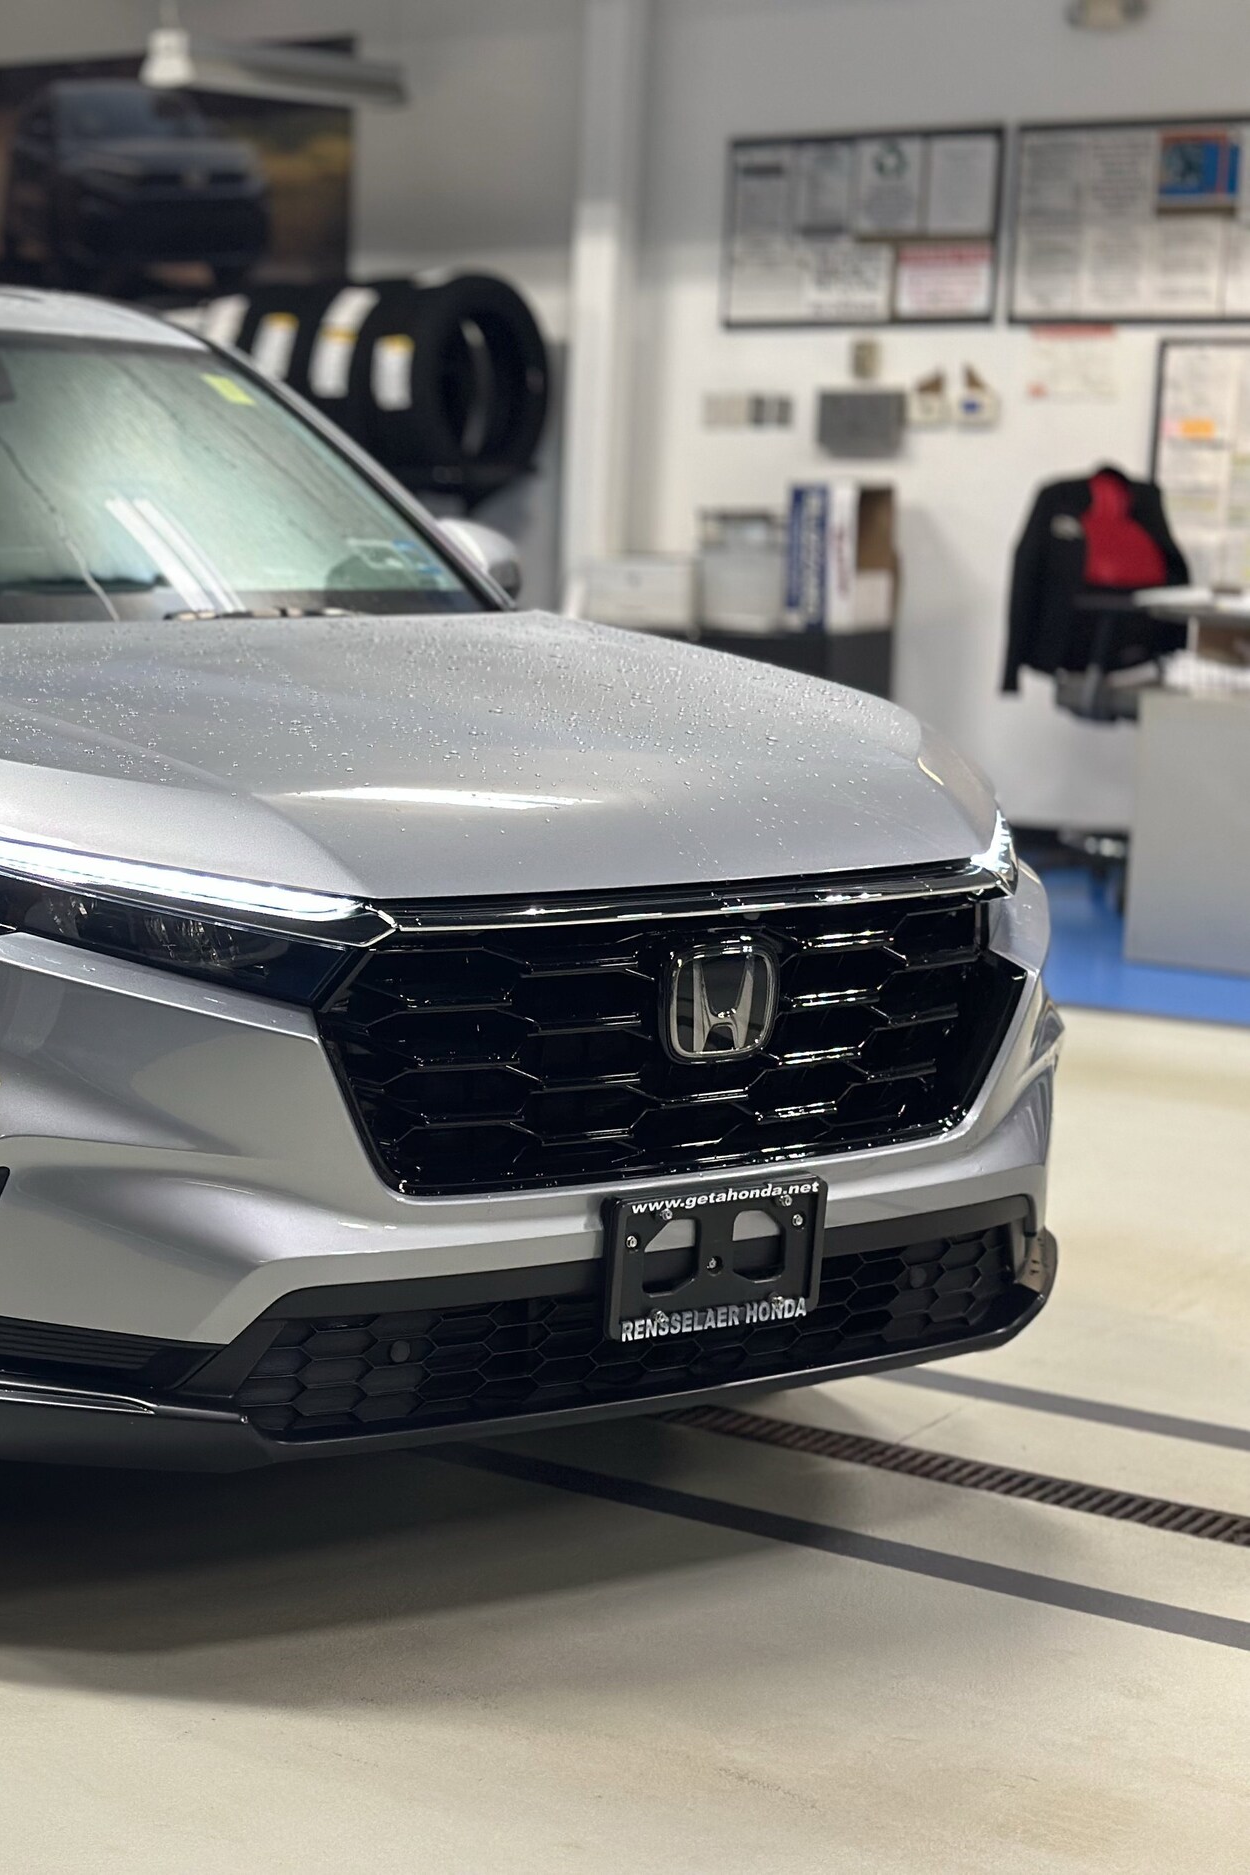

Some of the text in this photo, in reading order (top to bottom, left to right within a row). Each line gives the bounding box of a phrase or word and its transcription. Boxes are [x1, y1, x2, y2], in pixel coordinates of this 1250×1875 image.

[632, 1181, 820, 1214] www.getahonda.net
[621, 1297, 807, 1342] RENSSELAER HONDA
